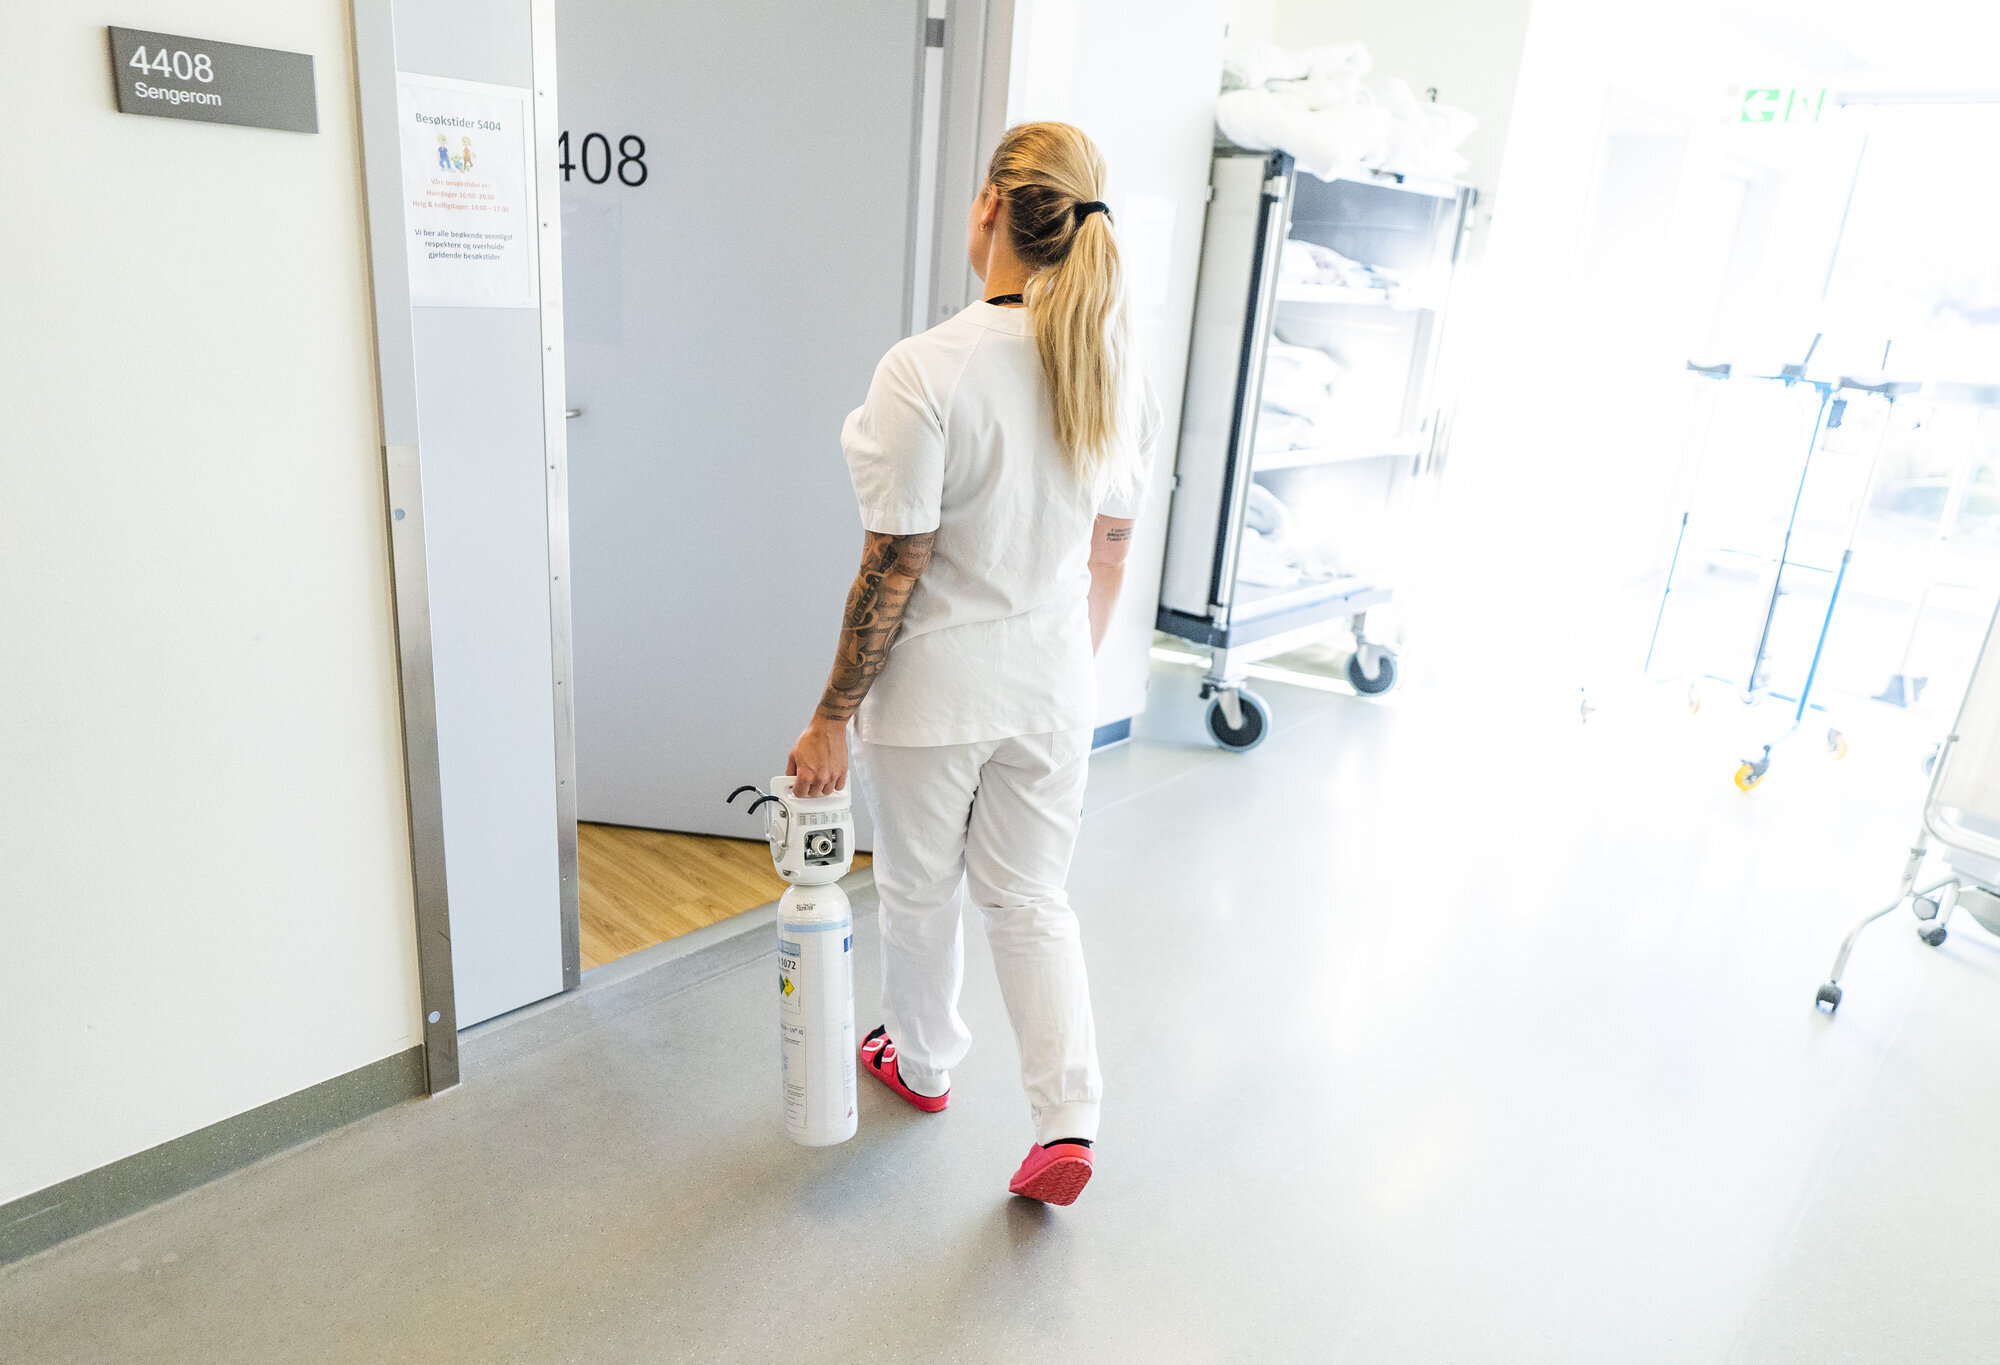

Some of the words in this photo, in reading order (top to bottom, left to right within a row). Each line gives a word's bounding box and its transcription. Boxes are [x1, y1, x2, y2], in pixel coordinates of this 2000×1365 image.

[129, 45, 214, 83] 4408
[134, 81, 222, 106] Sengerom
[415, 112, 475, 128] Besøkstider
[477, 119, 502, 132] S404
[412, 200, 427, 209] Helg
[414, 228, 422, 236] Vi
[424, 241, 461, 249] respektere
[428, 251, 462, 259] gjeldende
[463, 252, 500, 260] besøkstider
[781, 957, 796, 970] 1072
